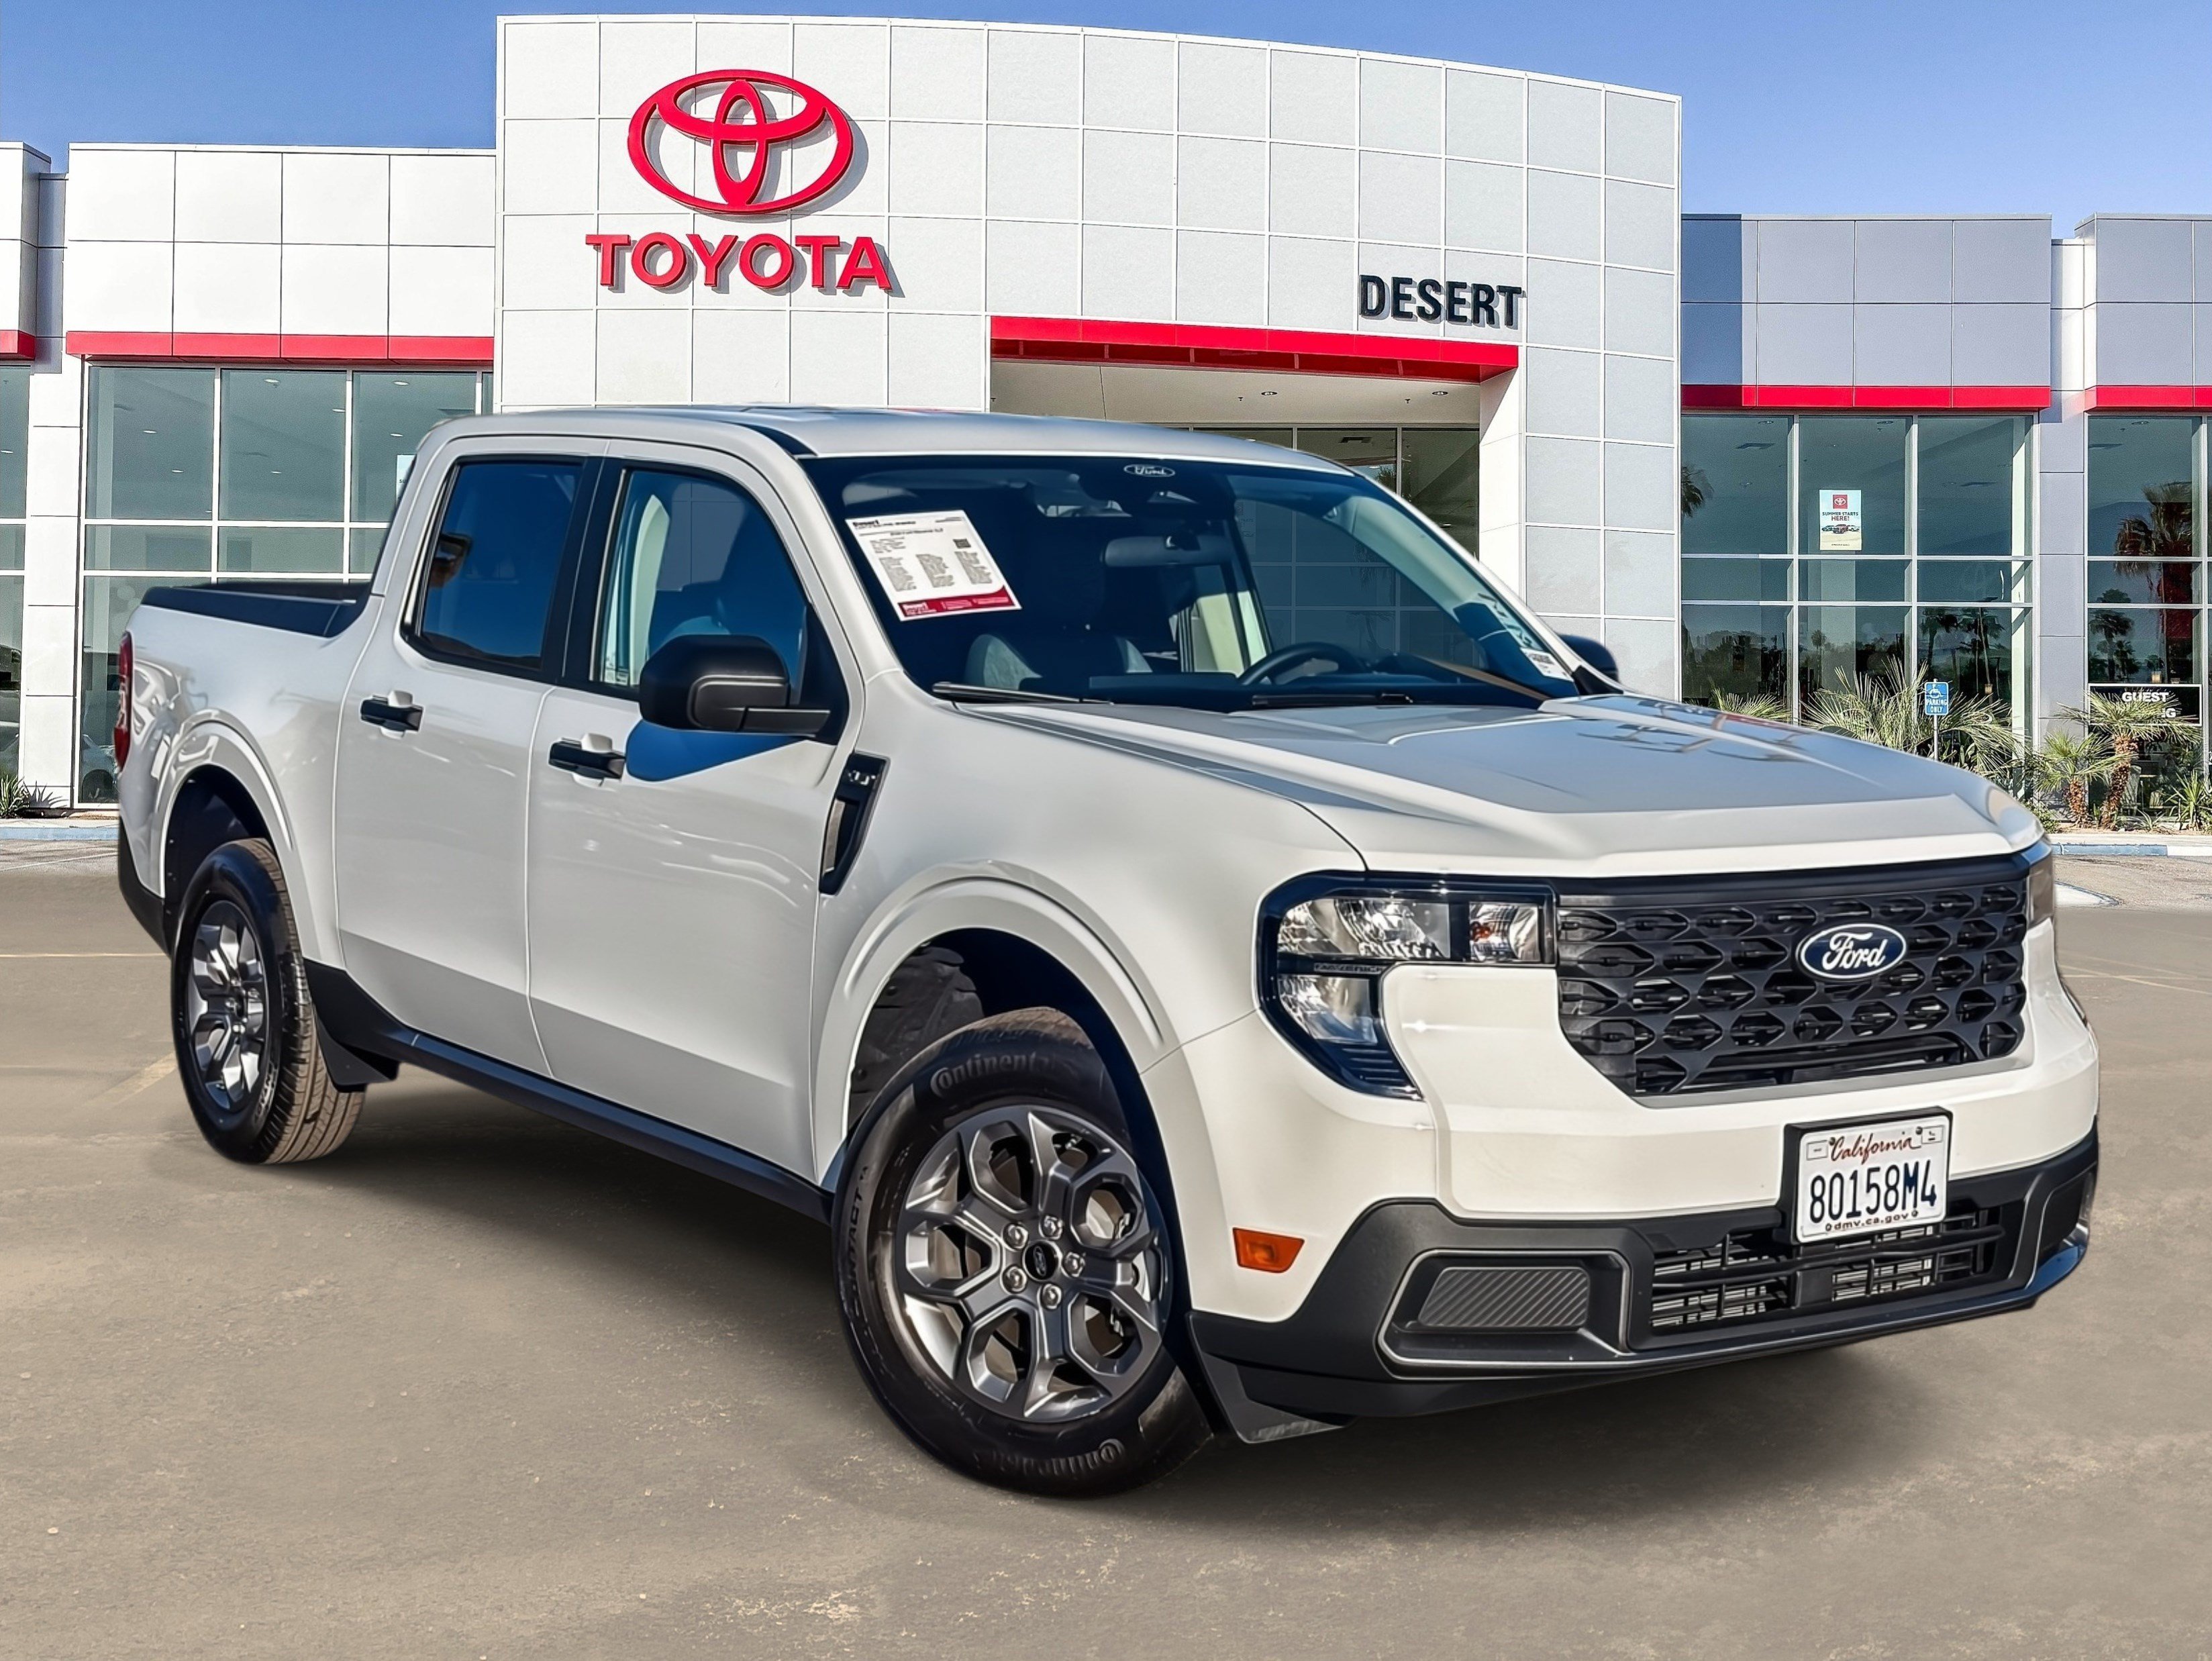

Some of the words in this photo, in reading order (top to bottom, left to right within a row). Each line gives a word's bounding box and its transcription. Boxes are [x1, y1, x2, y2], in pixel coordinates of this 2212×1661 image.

[585, 232, 893, 291] TOYOTA
[1359, 274, 1522, 326] DESERT
[2121, 691, 2170, 703] GUEST
[1821, 932, 1889, 970] Ford
[1831, 1131, 1921, 1165] California
[1809, 1158, 1937, 1223] 80158M4
[1834, 1212, 1909, 1229] dmv.ca.gov
